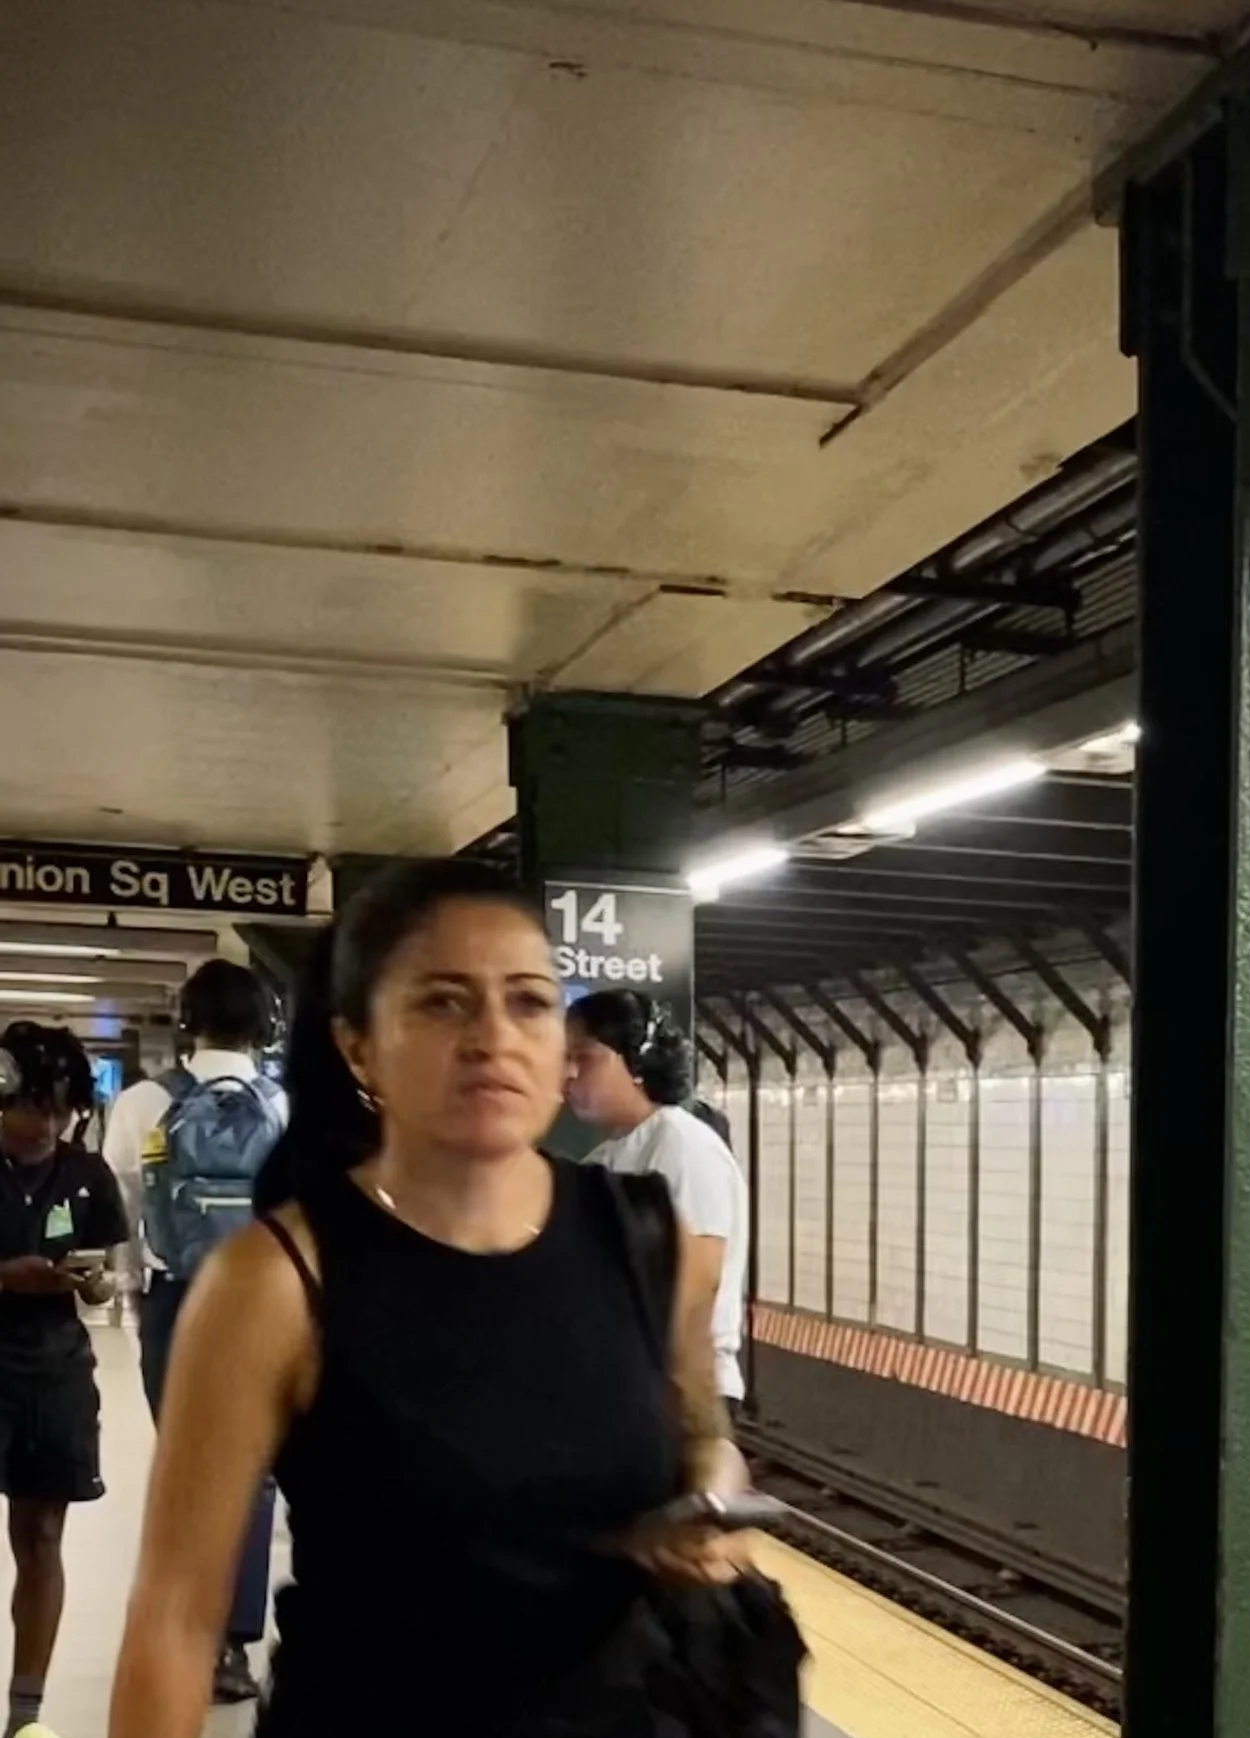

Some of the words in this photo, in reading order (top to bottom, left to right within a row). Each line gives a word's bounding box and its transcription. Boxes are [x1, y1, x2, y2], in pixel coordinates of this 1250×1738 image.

[0, 856, 91, 894] nion
[109, 860, 170, 905] Sq
[188, 866, 296, 905] West
[551, 889, 624, 946] 14
[556, 945, 663, 983] Street
